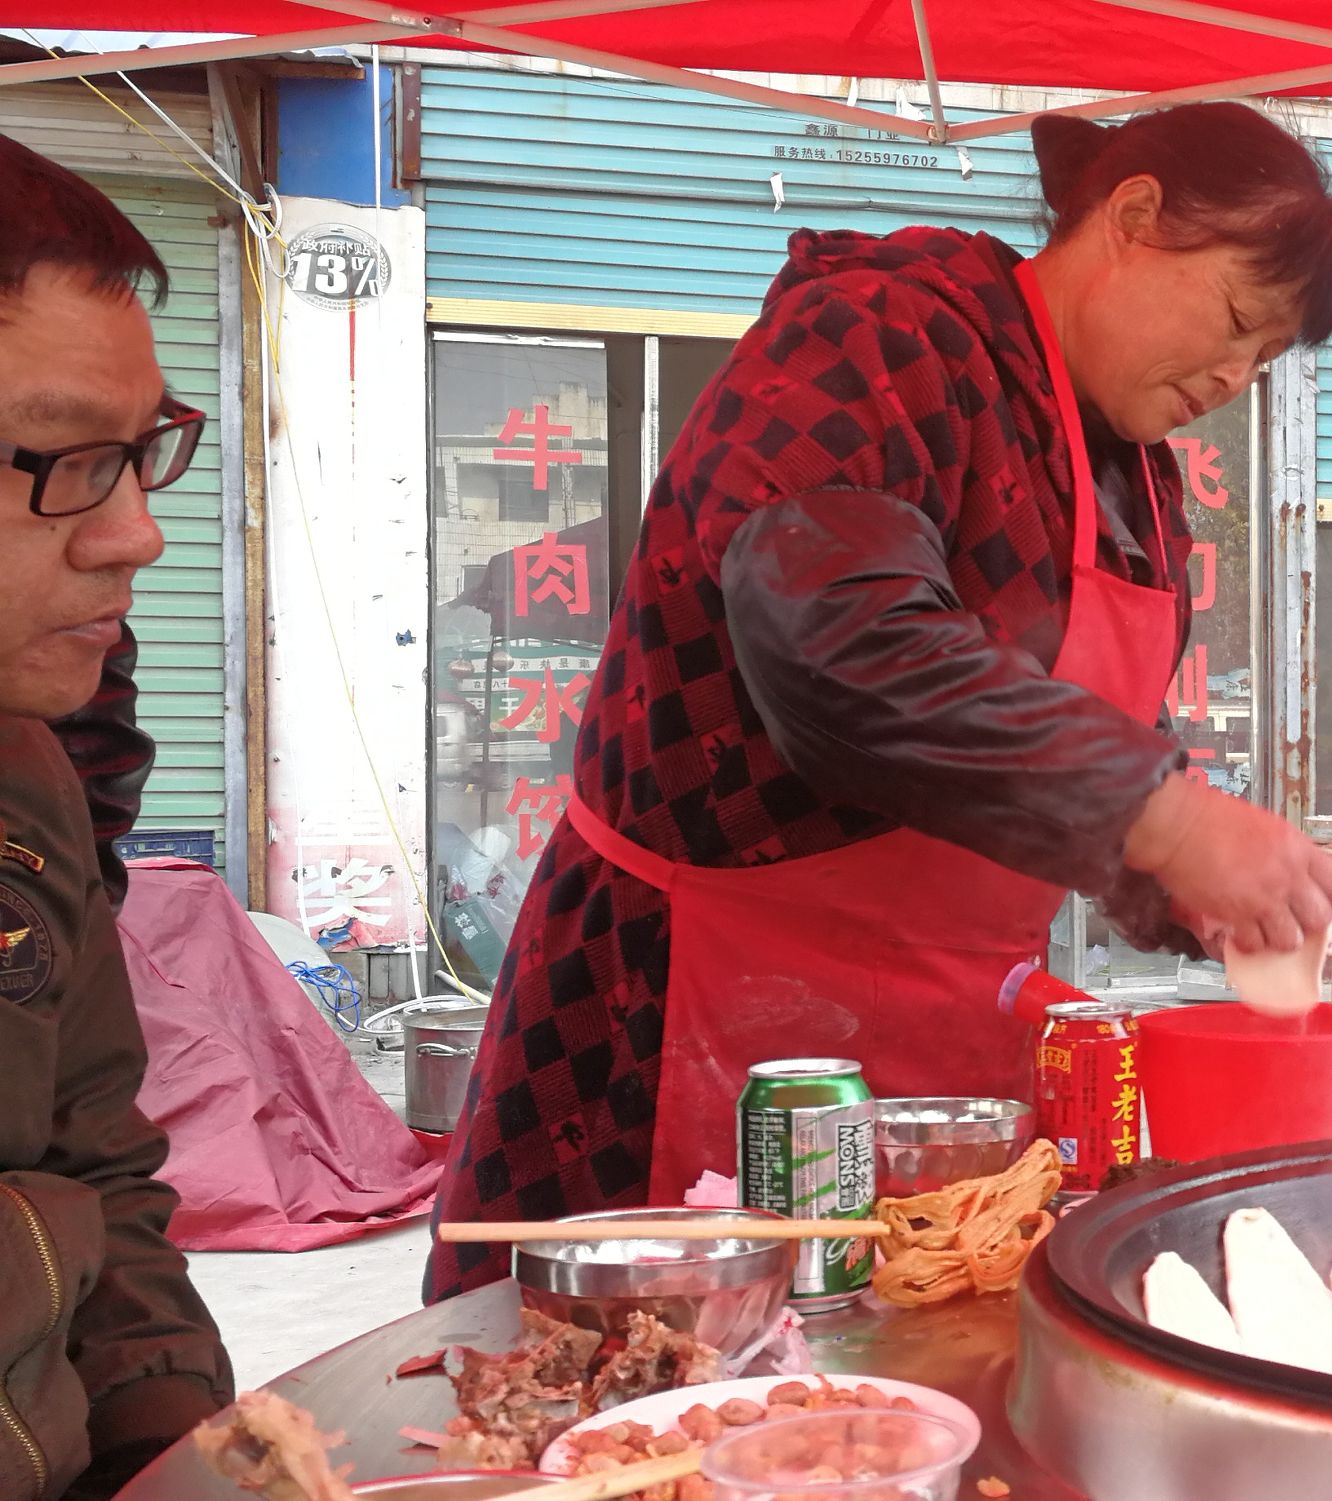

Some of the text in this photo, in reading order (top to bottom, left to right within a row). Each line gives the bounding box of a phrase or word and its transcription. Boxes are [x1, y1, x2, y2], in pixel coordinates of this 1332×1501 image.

[290, 252, 380, 297] 13%
[1111, 1044, 1137, 1164] 王老吉
